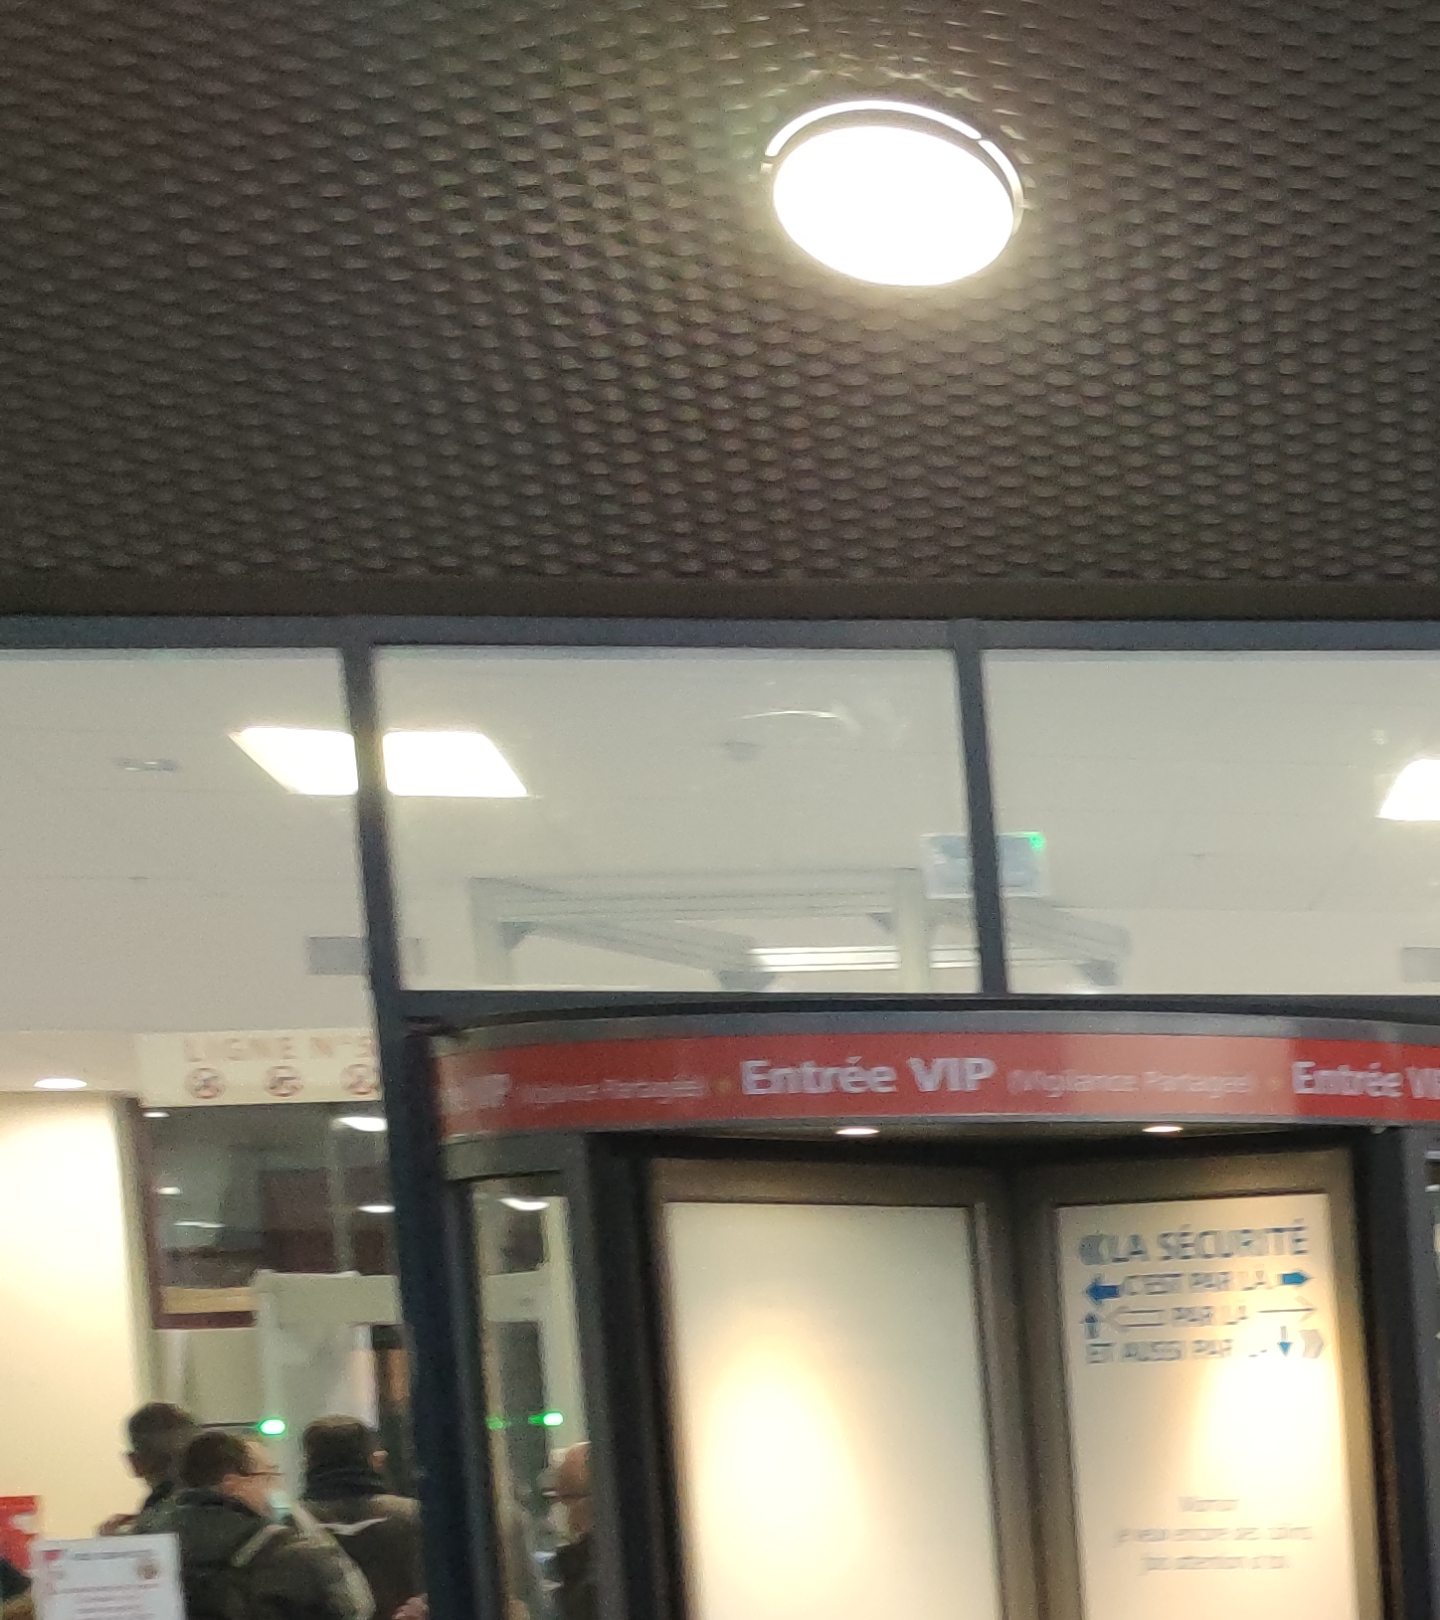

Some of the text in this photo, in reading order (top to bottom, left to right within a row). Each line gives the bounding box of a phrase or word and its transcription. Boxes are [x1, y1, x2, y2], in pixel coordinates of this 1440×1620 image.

[740, 1056, 898, 1095] Entrée
[906, 1056, 997, 1092] VIP
[1292, 1062, 1403, 1098] Entrée
[1110, 1217, 1309, 1263] LA SÉCURITÉ
[1190, 1270, 1231, 1294] PAR
[1170, 1305, 1214, 1328] PAR
[1085, 1341, 1115, 1365] ET
